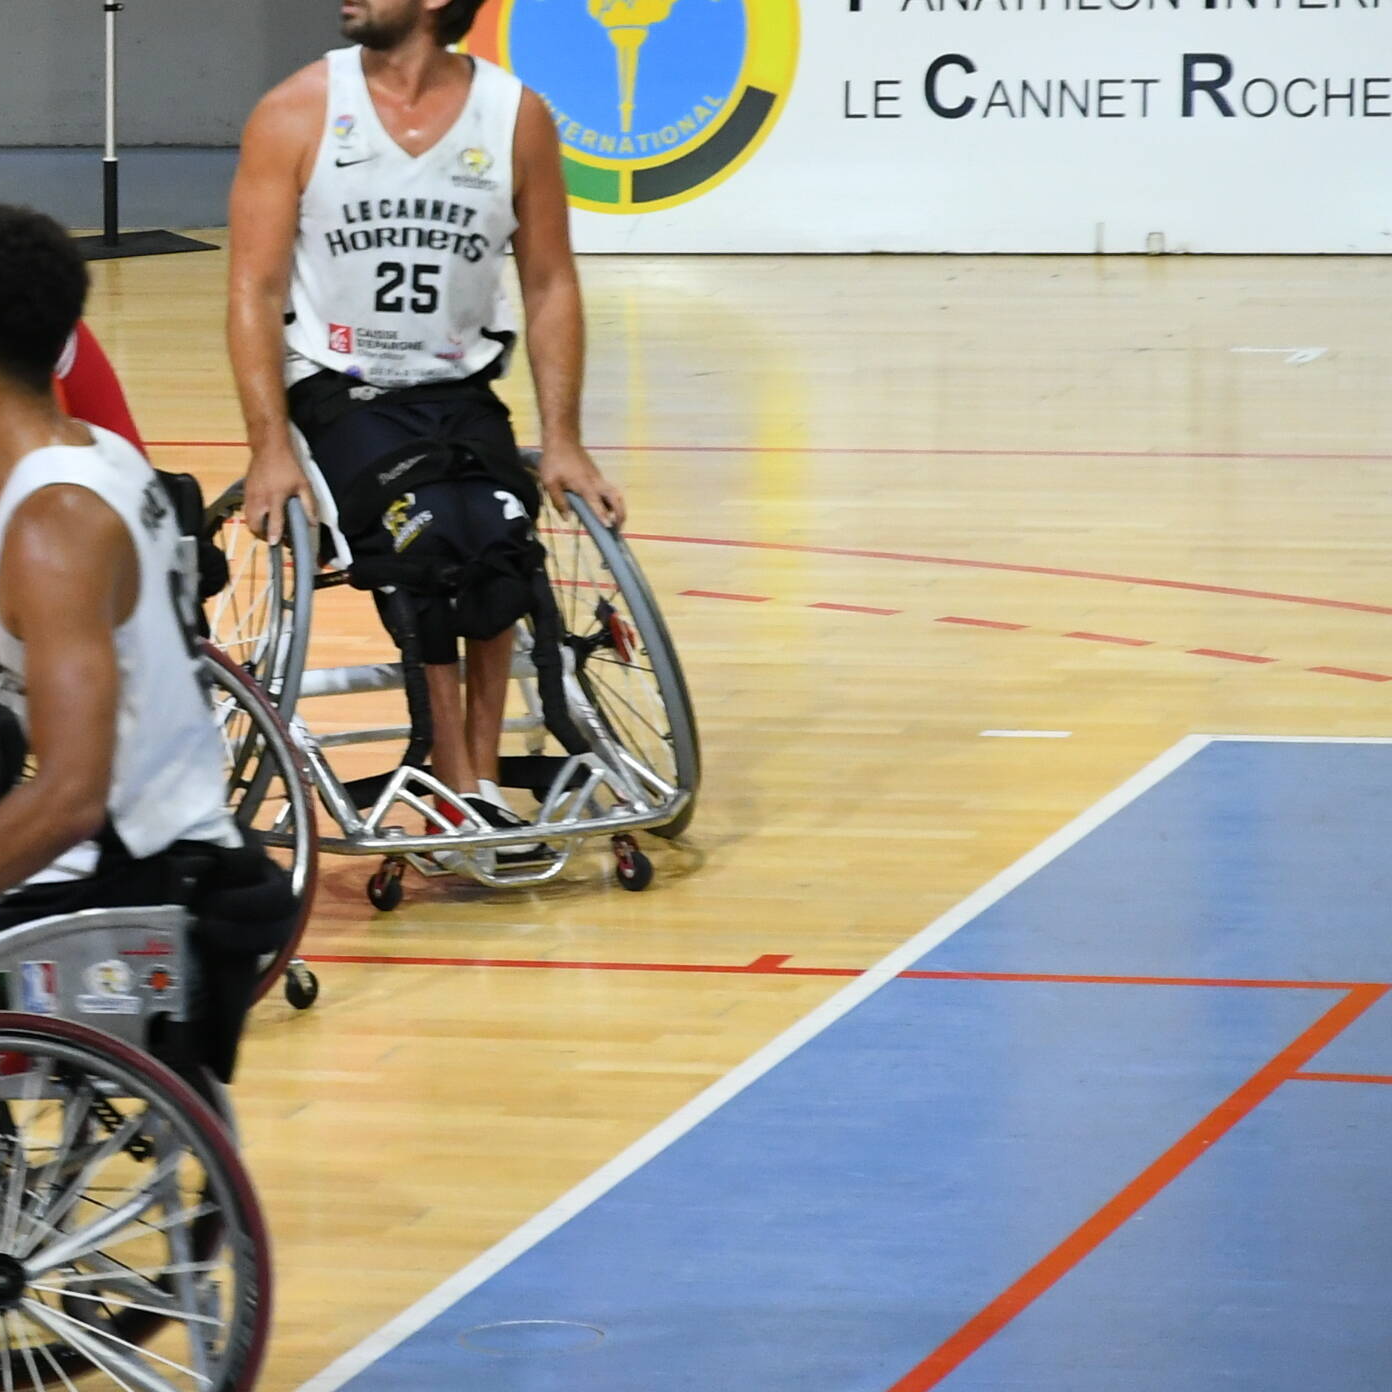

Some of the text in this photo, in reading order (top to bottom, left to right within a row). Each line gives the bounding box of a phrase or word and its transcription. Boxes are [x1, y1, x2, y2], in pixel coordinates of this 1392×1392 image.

[844, 80, 902, 119] LE
[923, 52, 1161, 119] CANNET
[374, 260, 441, 314] 25
